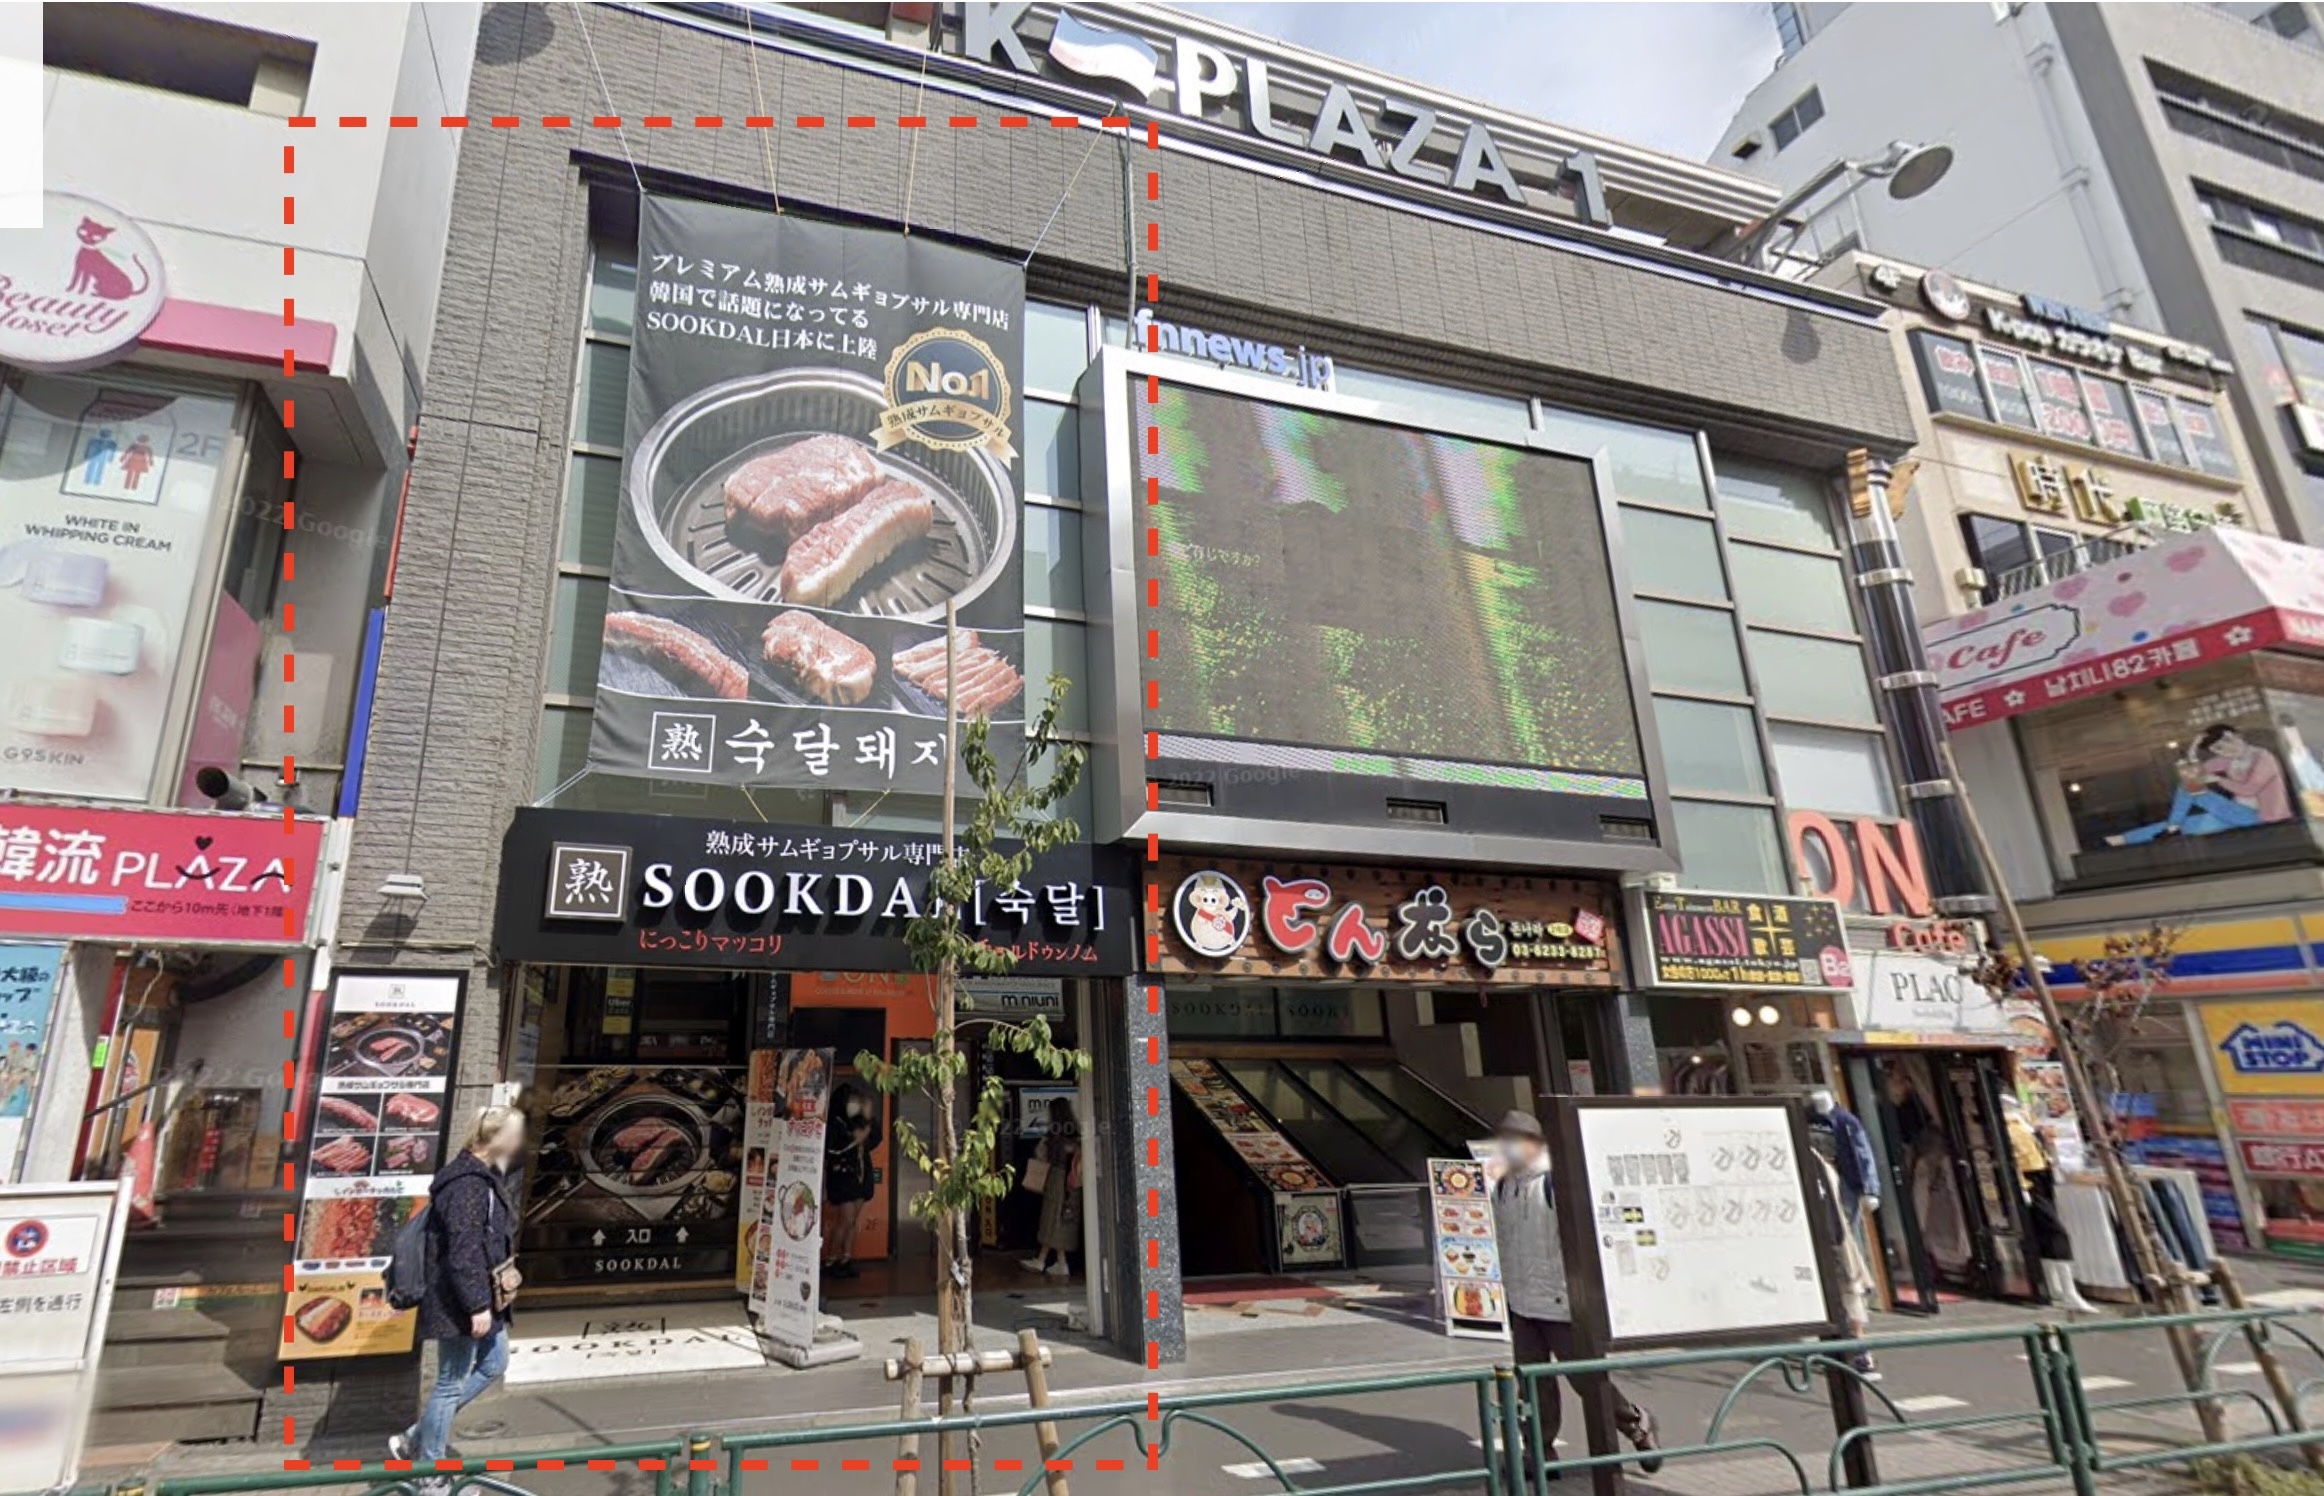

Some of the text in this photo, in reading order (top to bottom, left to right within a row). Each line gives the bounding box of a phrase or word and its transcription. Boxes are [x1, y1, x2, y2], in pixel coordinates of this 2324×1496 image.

[1174, 35, 1527, 206] PLAZA
[1557, 149, 1613, 228] 1
[650, 280, 869, 329] 韓国で話題になってる
[647, 311, 878, 361] SOOKDAL日本に上陸
[1134, 308, 1332, 391] fnnews.jp
[177, 431, 225, 457] 2F
[25, 524, 172, 553] WHIPPING CREAM
[65, 514, 141, 534] WHITE IN
[5, 745, 85, 767] G9SKIN
[661, 723, 702, 761] 熟
[111, 850, 293, 893] PLAZA
[564, 858, 614, 905] 熟
[639, 928, 783, 956] にっこりマッコリ
[1658, 913, 1749, 957] AGASSI
[626, 1228, 651, 1243] 入口
[595, 1255, 682, 1273] SOOKDAL
